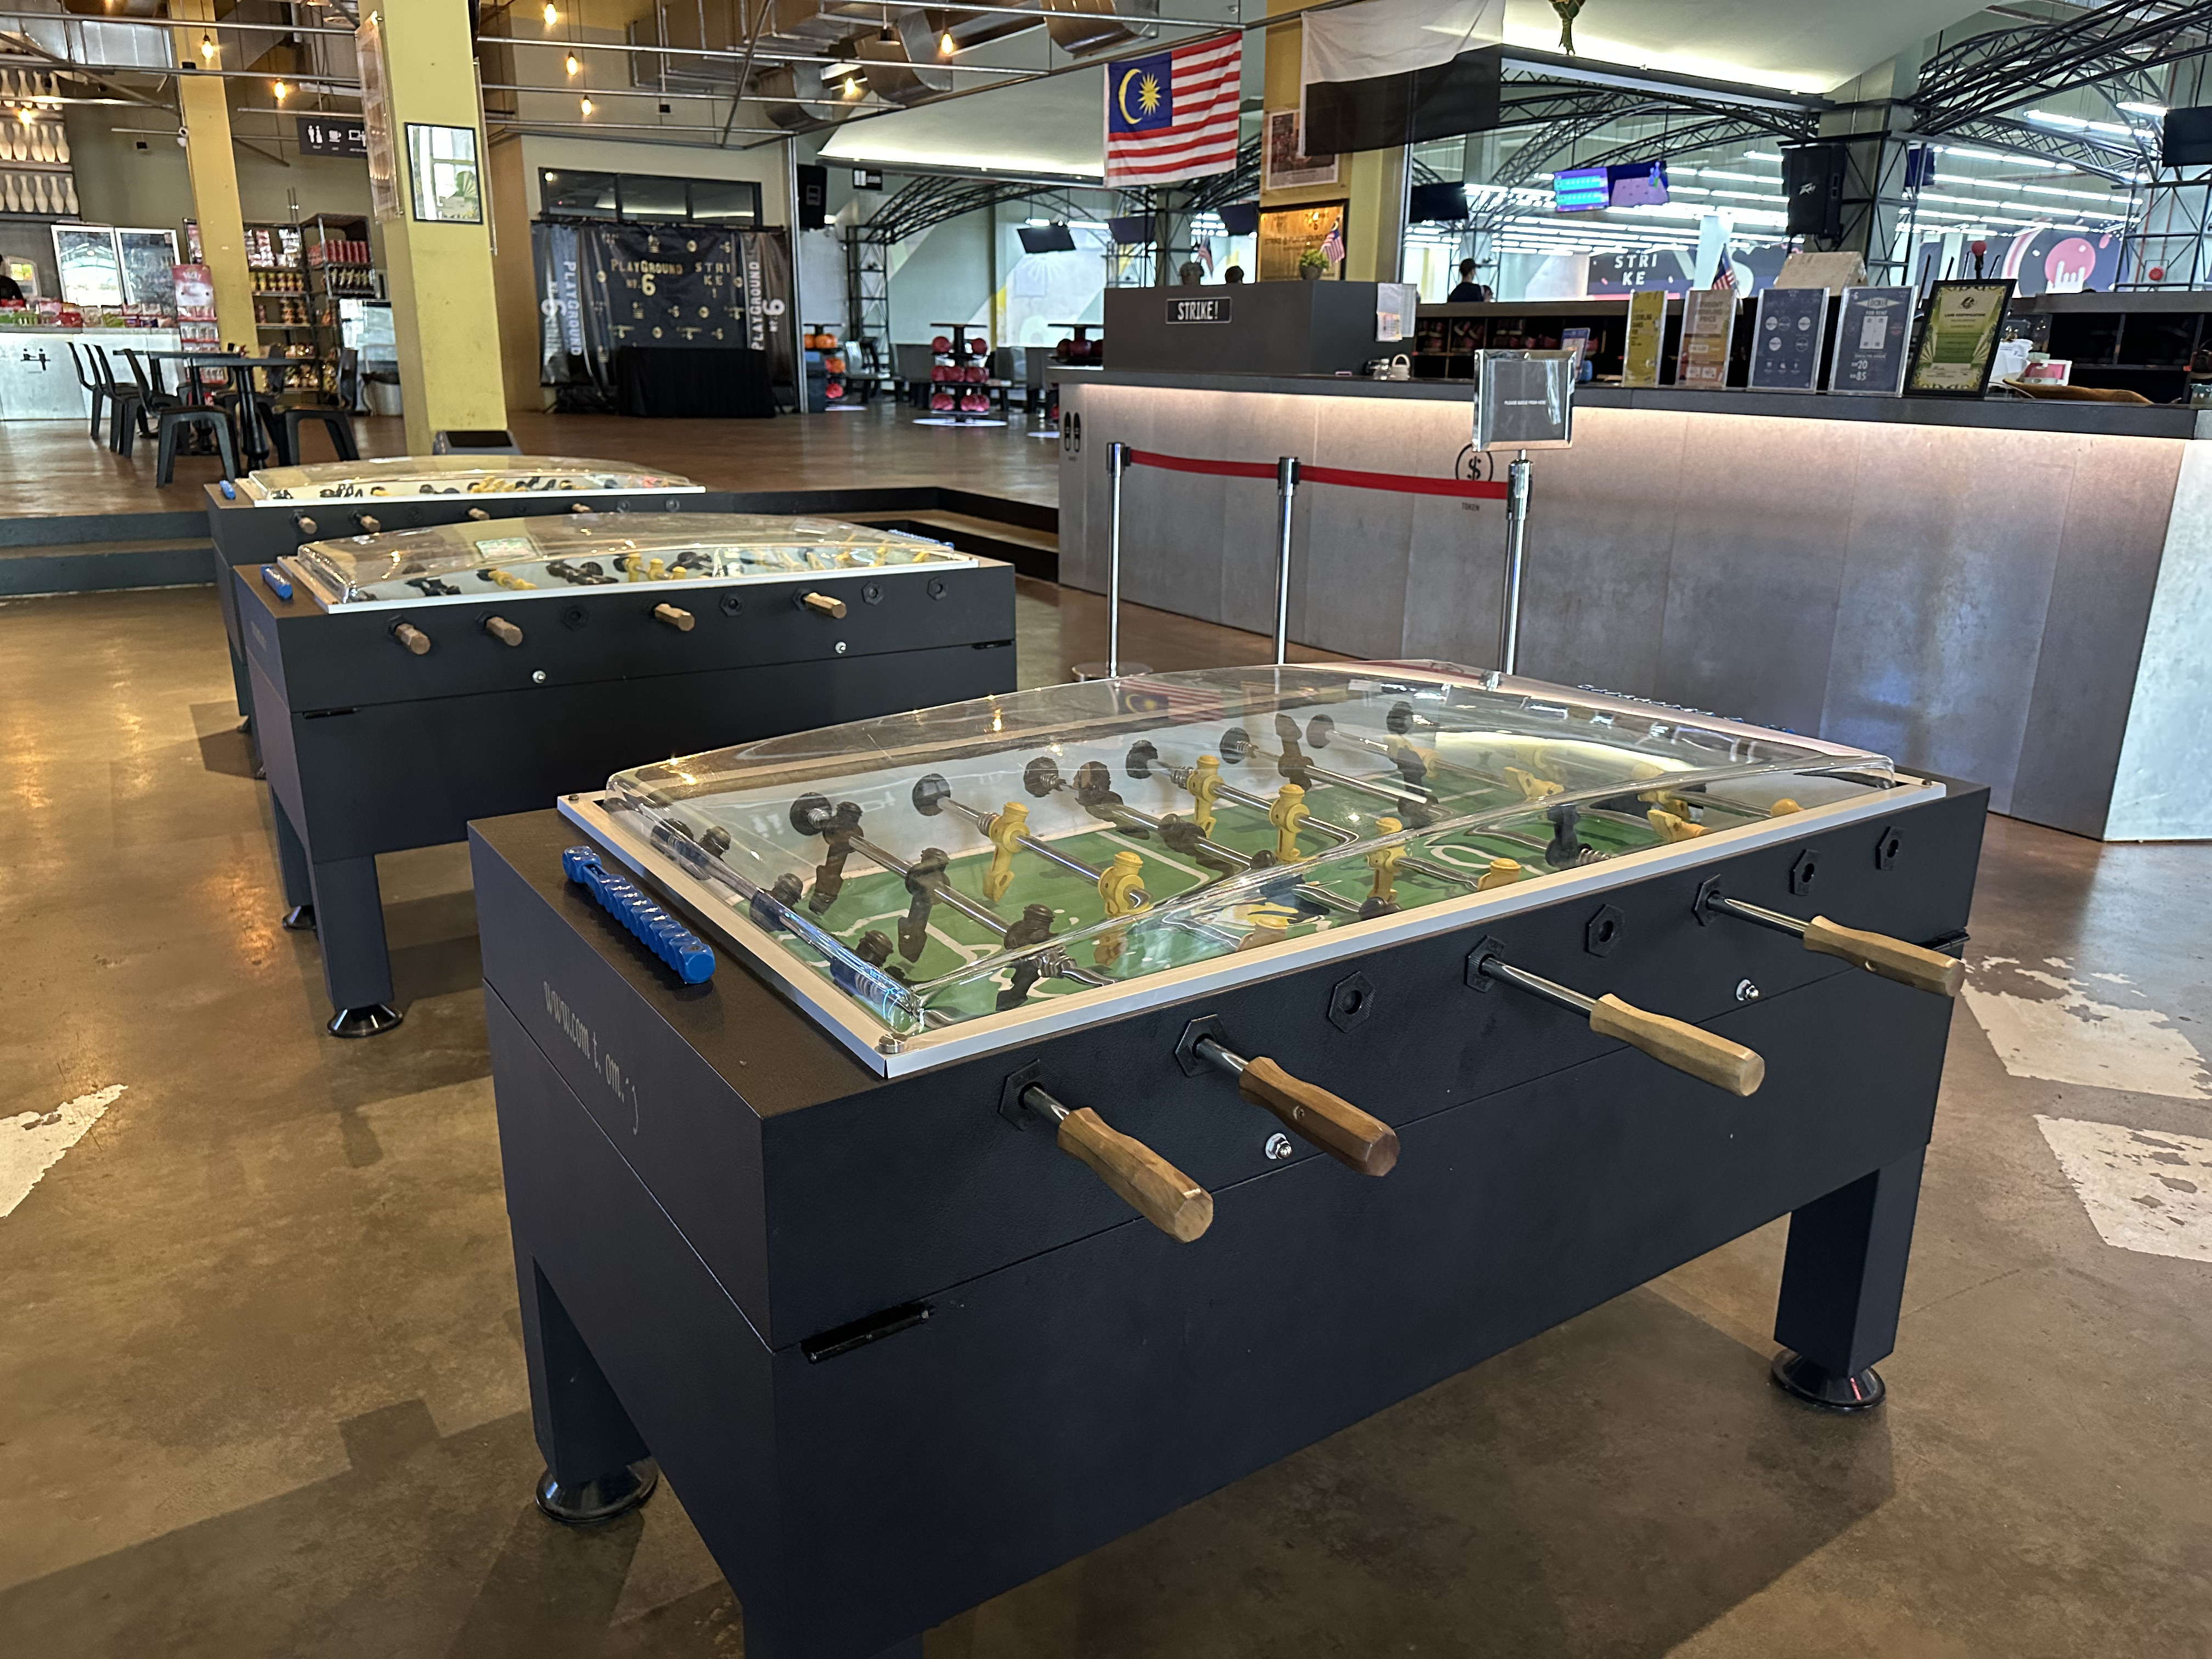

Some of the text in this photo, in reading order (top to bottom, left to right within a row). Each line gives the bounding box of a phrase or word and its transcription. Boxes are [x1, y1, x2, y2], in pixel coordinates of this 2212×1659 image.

[611, 259, 683, 275] PLAYGROUND
[695, 261, 731, 274] STRI
[1614, 253, 1657, 269] STRI
[641, 273, 656, 296] 6
[703, 275, 724, 286] KE
[1622, 271, 1645, 286] KE
[563, 261, 582, 356] PLAYGROUND
[748, 261, 765, 351] PLAYGROUND
[1177, 300, 1218, 320] STRIKE!
